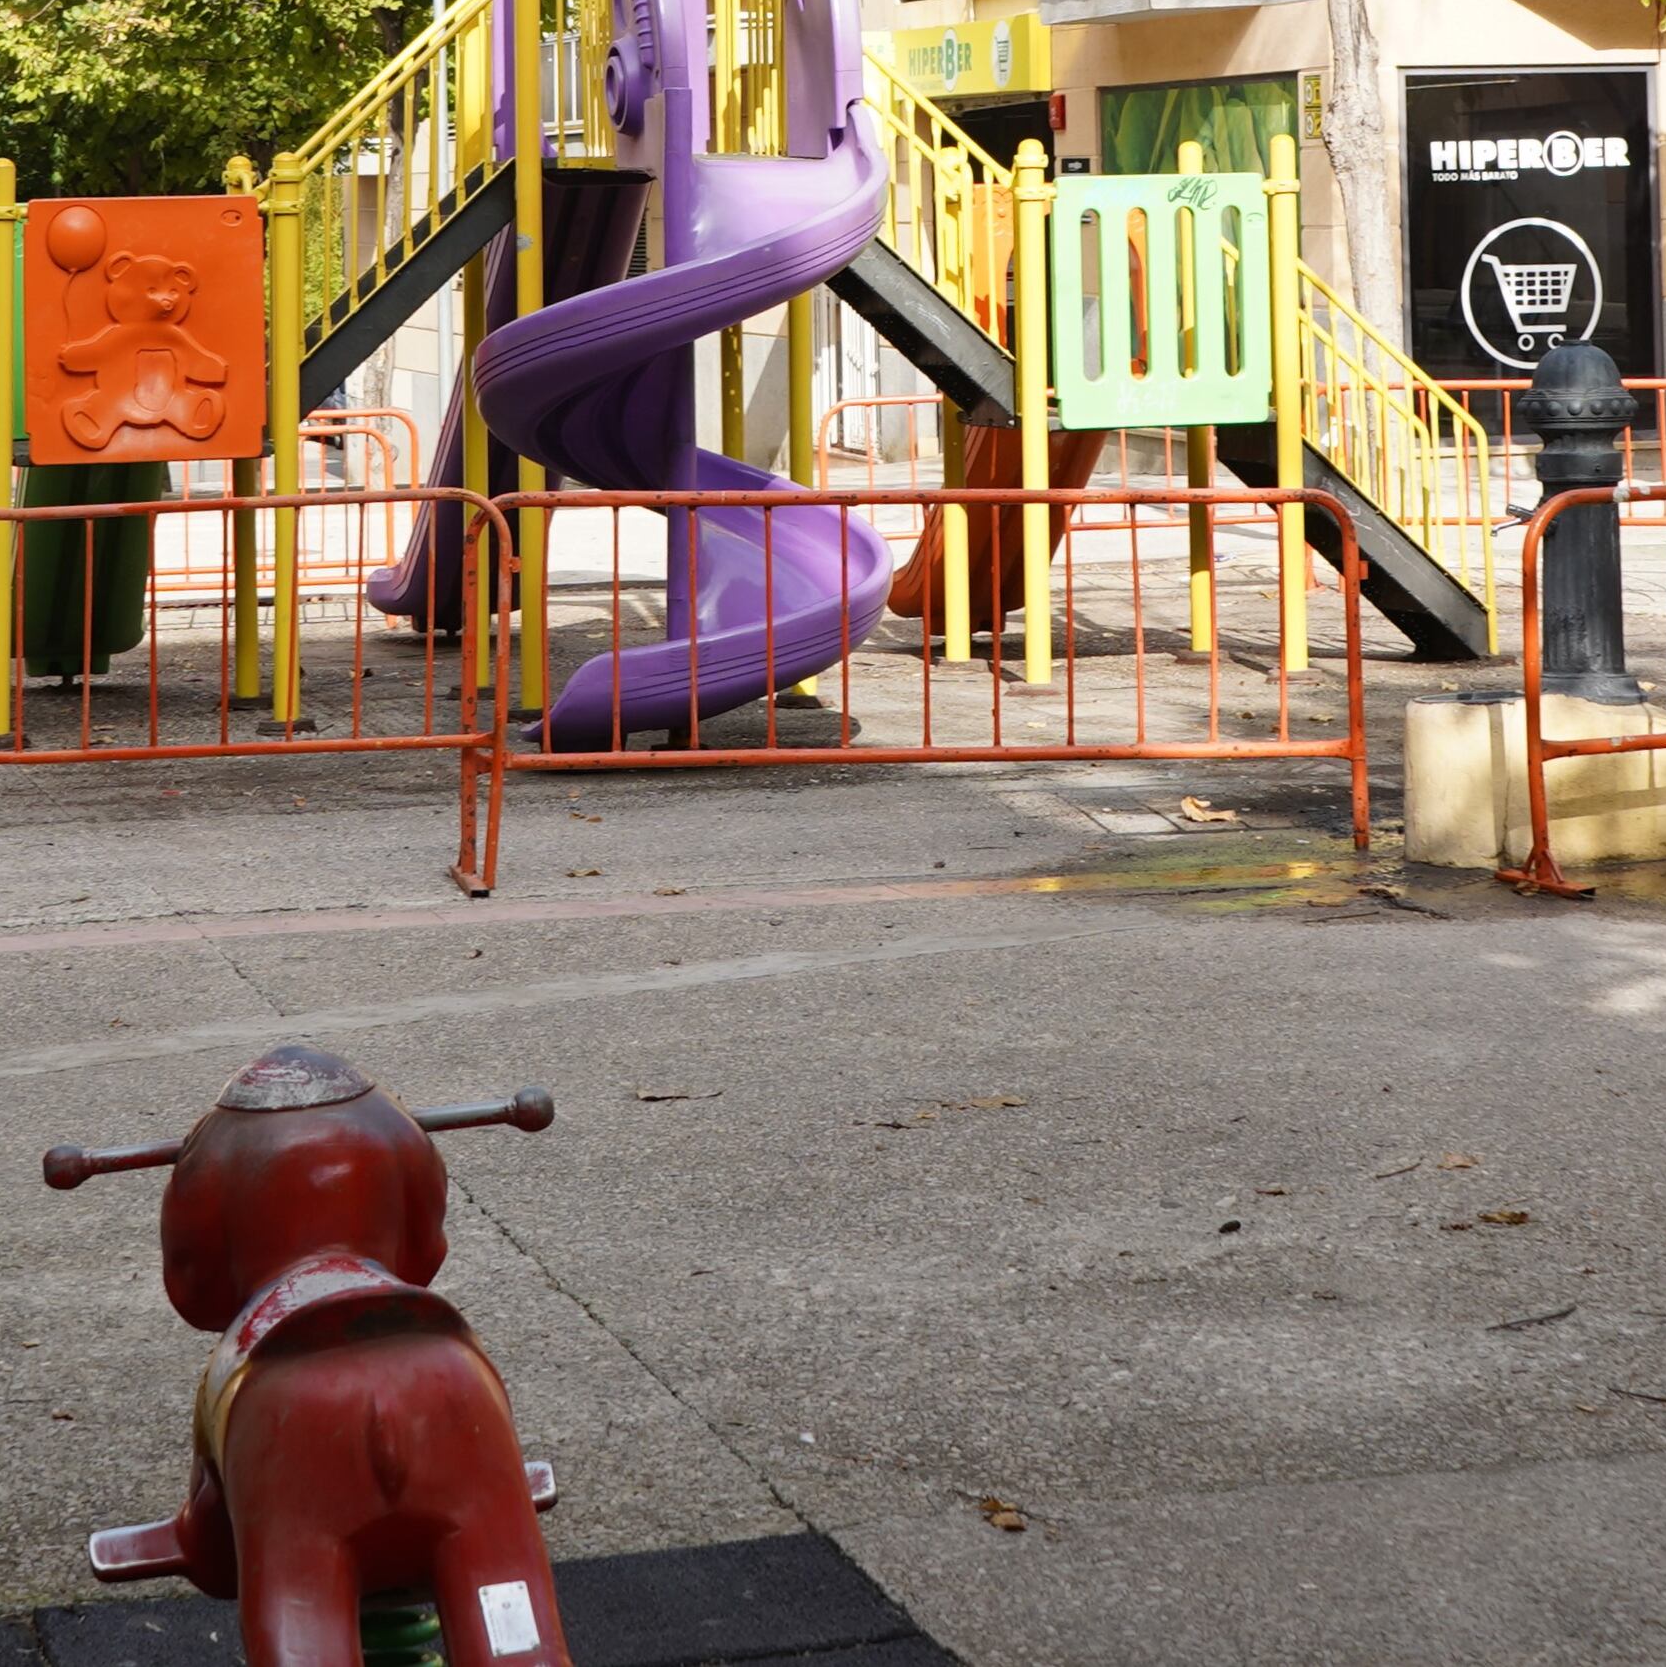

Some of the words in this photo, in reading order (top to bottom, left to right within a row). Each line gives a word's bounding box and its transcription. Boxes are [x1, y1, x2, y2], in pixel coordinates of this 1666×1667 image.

[908, 38, 973, 80] HIPERBER
[1430, 132, 1631, 176] HIPERBER
[1432, 172, 1458, 182] TODO
[1482, 170, 1519, 181] BARATO
